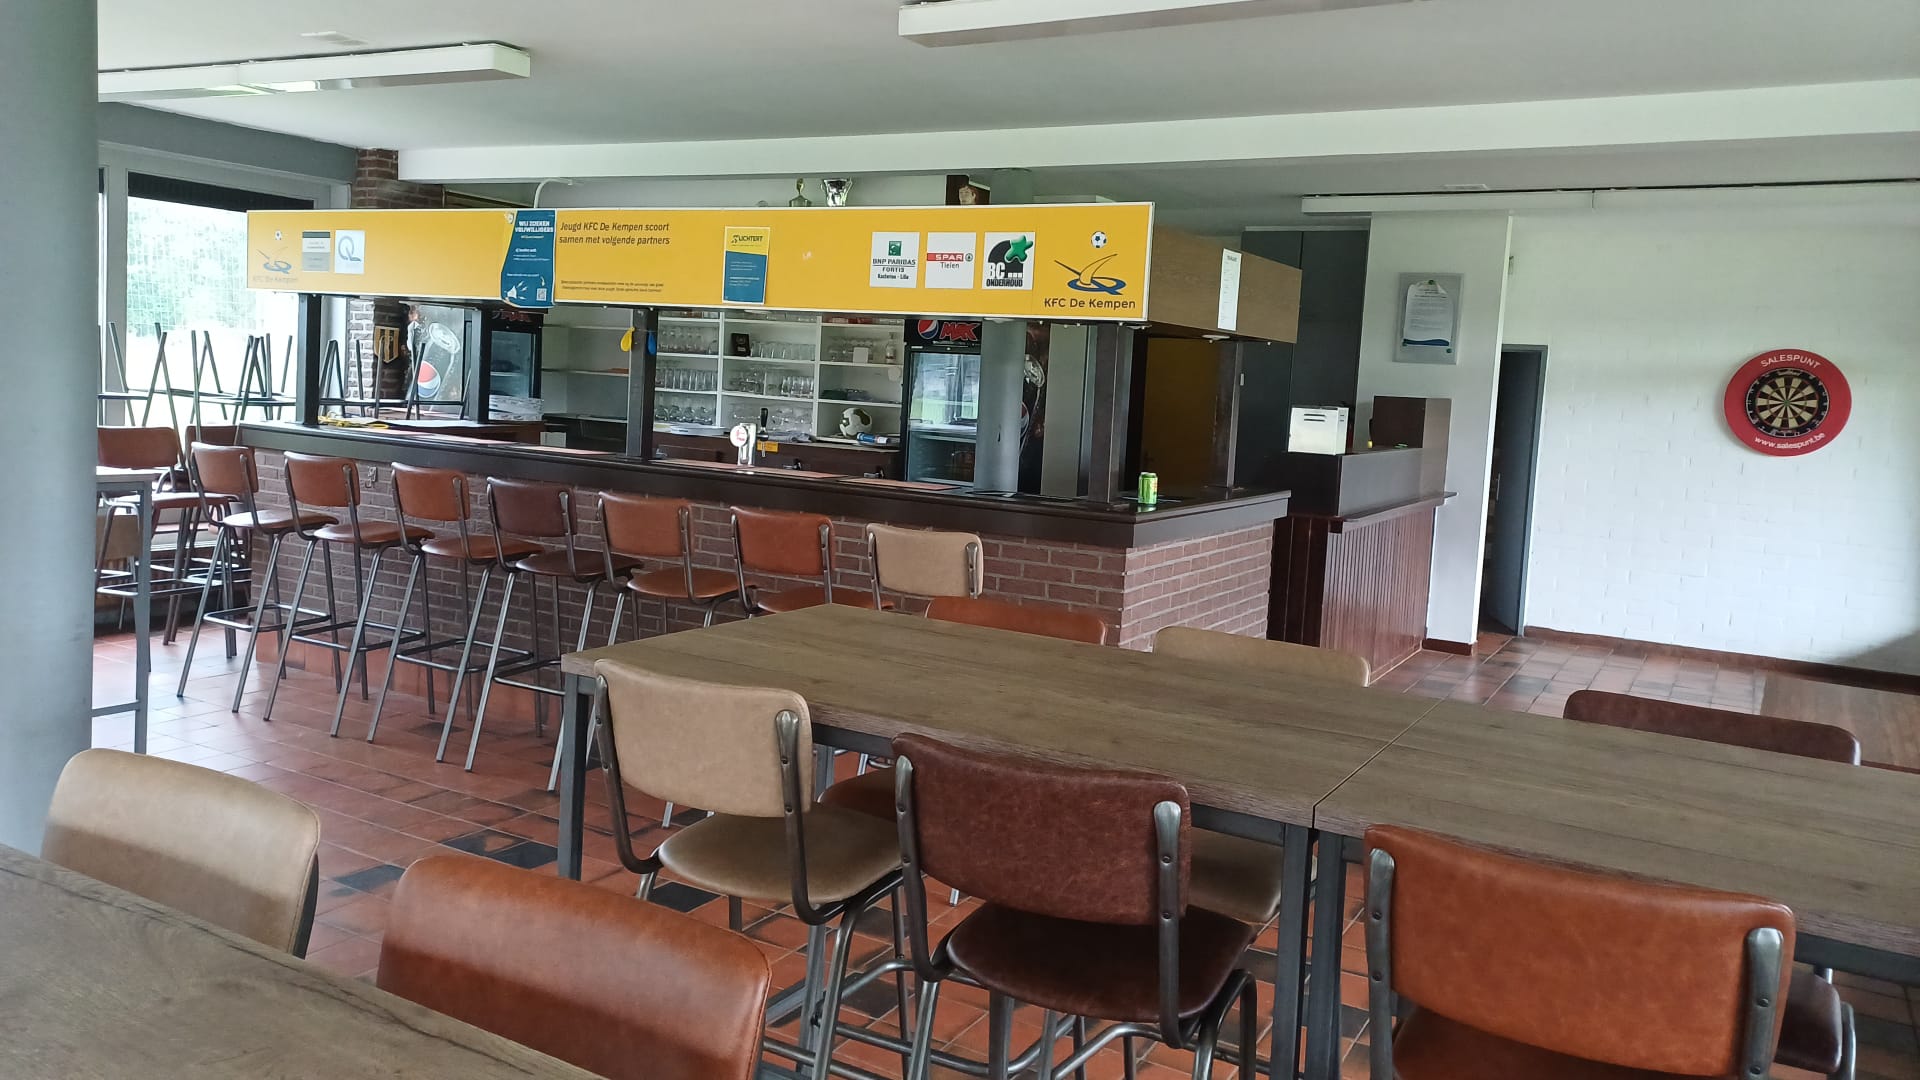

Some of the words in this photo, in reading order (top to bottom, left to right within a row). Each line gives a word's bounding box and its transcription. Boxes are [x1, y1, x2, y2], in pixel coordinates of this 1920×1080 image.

[560, 222, 581, 232] Jeugd
[583, 222, 598, 230] KFC
[600, 222, 610, 231] De
[612, 222, 643, 232] Kempen
[645, 223, 669, 231] scoort
[602, 235, 636, 246] volgende
[637, 236, 670, 246] partners
[986, 278, 1023, 287] ONDERHOUD
[1044, 298, 1066, 308] KFC
[1069, 298, 1085, 308] De
[1089, 298, 1136, 310] Kempen
[1760, 354, 1822, 369] SALESPUNT
[1754, 432, 1826, 449] www.salespunt.be
